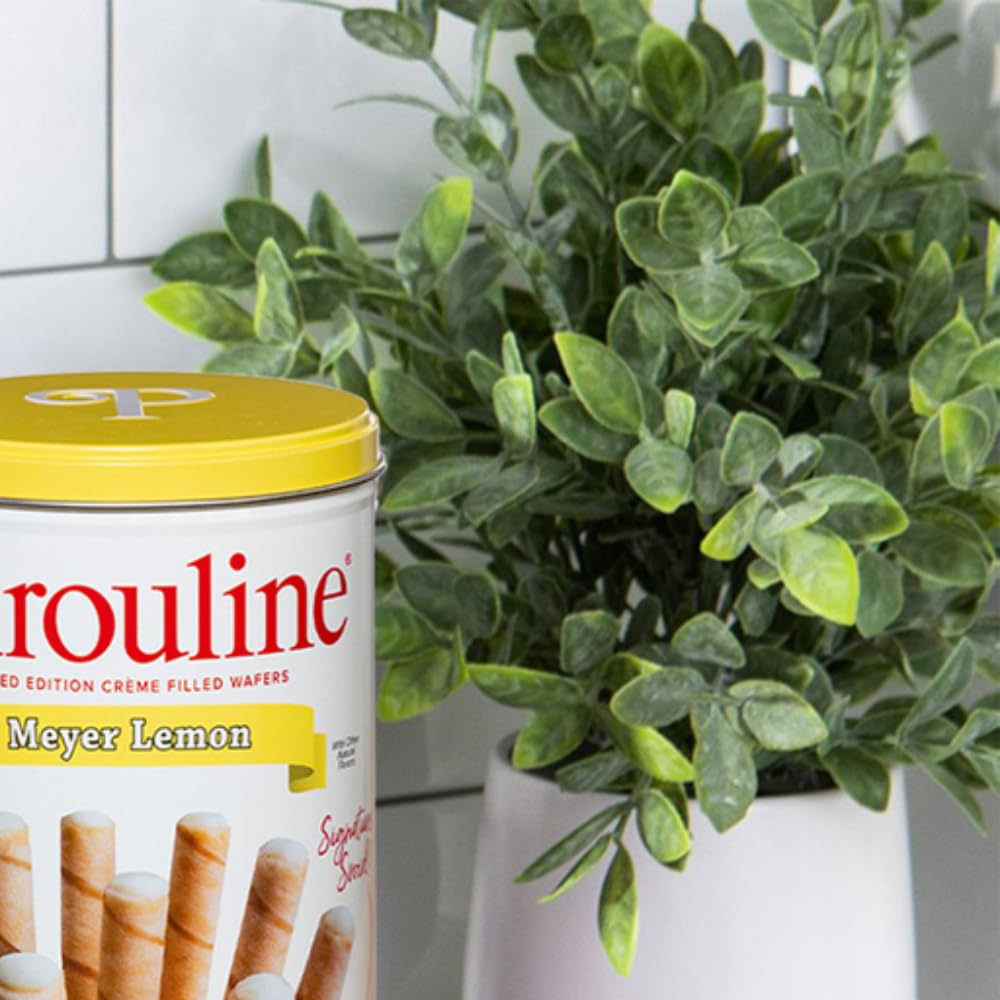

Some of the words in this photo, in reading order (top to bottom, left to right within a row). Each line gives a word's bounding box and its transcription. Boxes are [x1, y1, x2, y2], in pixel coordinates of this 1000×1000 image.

[24, 387, 216, 421] P
[26, 675, 94, 694] EDITION
[101, 672, 159, 694] CRÈME
[167, 675, 223, 694] FILLED
[229, 669, 290, 691] WAFERS
[6, 716, 121, 761] Meyer
[130, 719, 252, 752] Lemon
